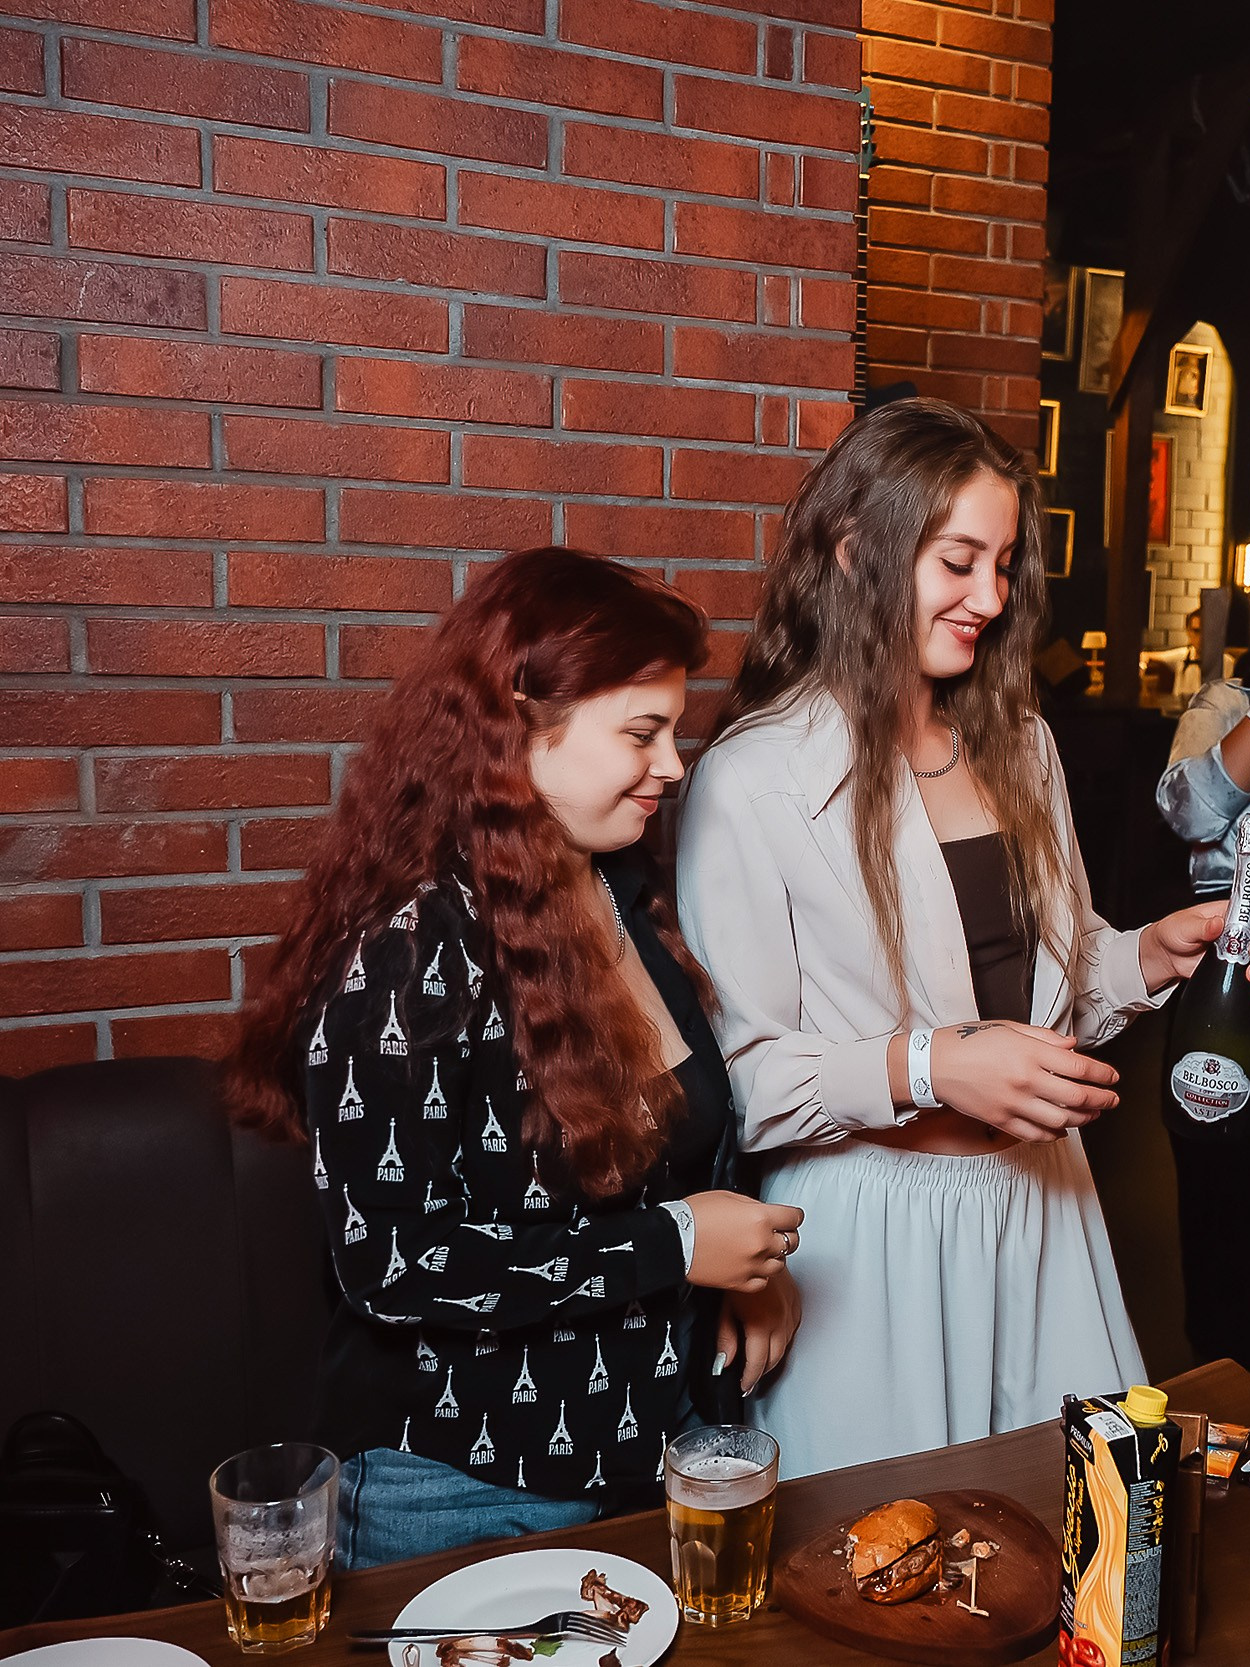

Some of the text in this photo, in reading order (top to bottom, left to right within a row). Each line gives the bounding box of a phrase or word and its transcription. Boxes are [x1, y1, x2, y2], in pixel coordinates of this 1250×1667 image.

[389, 916, 419, 931] PARIS
[344, 975, 367, 994] PARIS
[423, 980, 447, 997] PARIS
[482, 1023, 505, 1041] PARIS
[380, 1040, 408, 1056] PARIS
[308, 1049, 329, 1066] PARIS
[1182, 1070, 1239, 1091] BELBOSCO
[338, 1104, 364, 1122] PARIS
[423, 1105, 448, 1119] PARIS
[482, 1138, 507, 1153] PARIS
[377, 1167, 404, 1182] PARIS
[524, 1197, 549, 1209] PARIS
[345, 1225, 368, 1245] PARIS
[430, 1246, 450, 1273] PARIS
[553, 1256, 569, 1282] PARIS
[591, 1275, 605, 1298] PARIS
[479, 1292, 501, 1313] PARIS
[623, 1315, 647, 1329] PARIS
[553, 1330, 576, 1342] PARIS
[418, 1358, 439, 1372] ARIS
[654, 1361, 679, 1378] PARIS
[588, 1377, 609, 1395] PARIS
[512, 1389, 537, 1404] PARIS
[434, 1408, 460, 1418] PARIS
[617, 1424, 639, 1442] PARIS
[1070, 1425, 1093, 1454] PREMIUM
[469, 1449, 495, 1465] PARIS
[548, 1443, 574, 1455] PARIS
